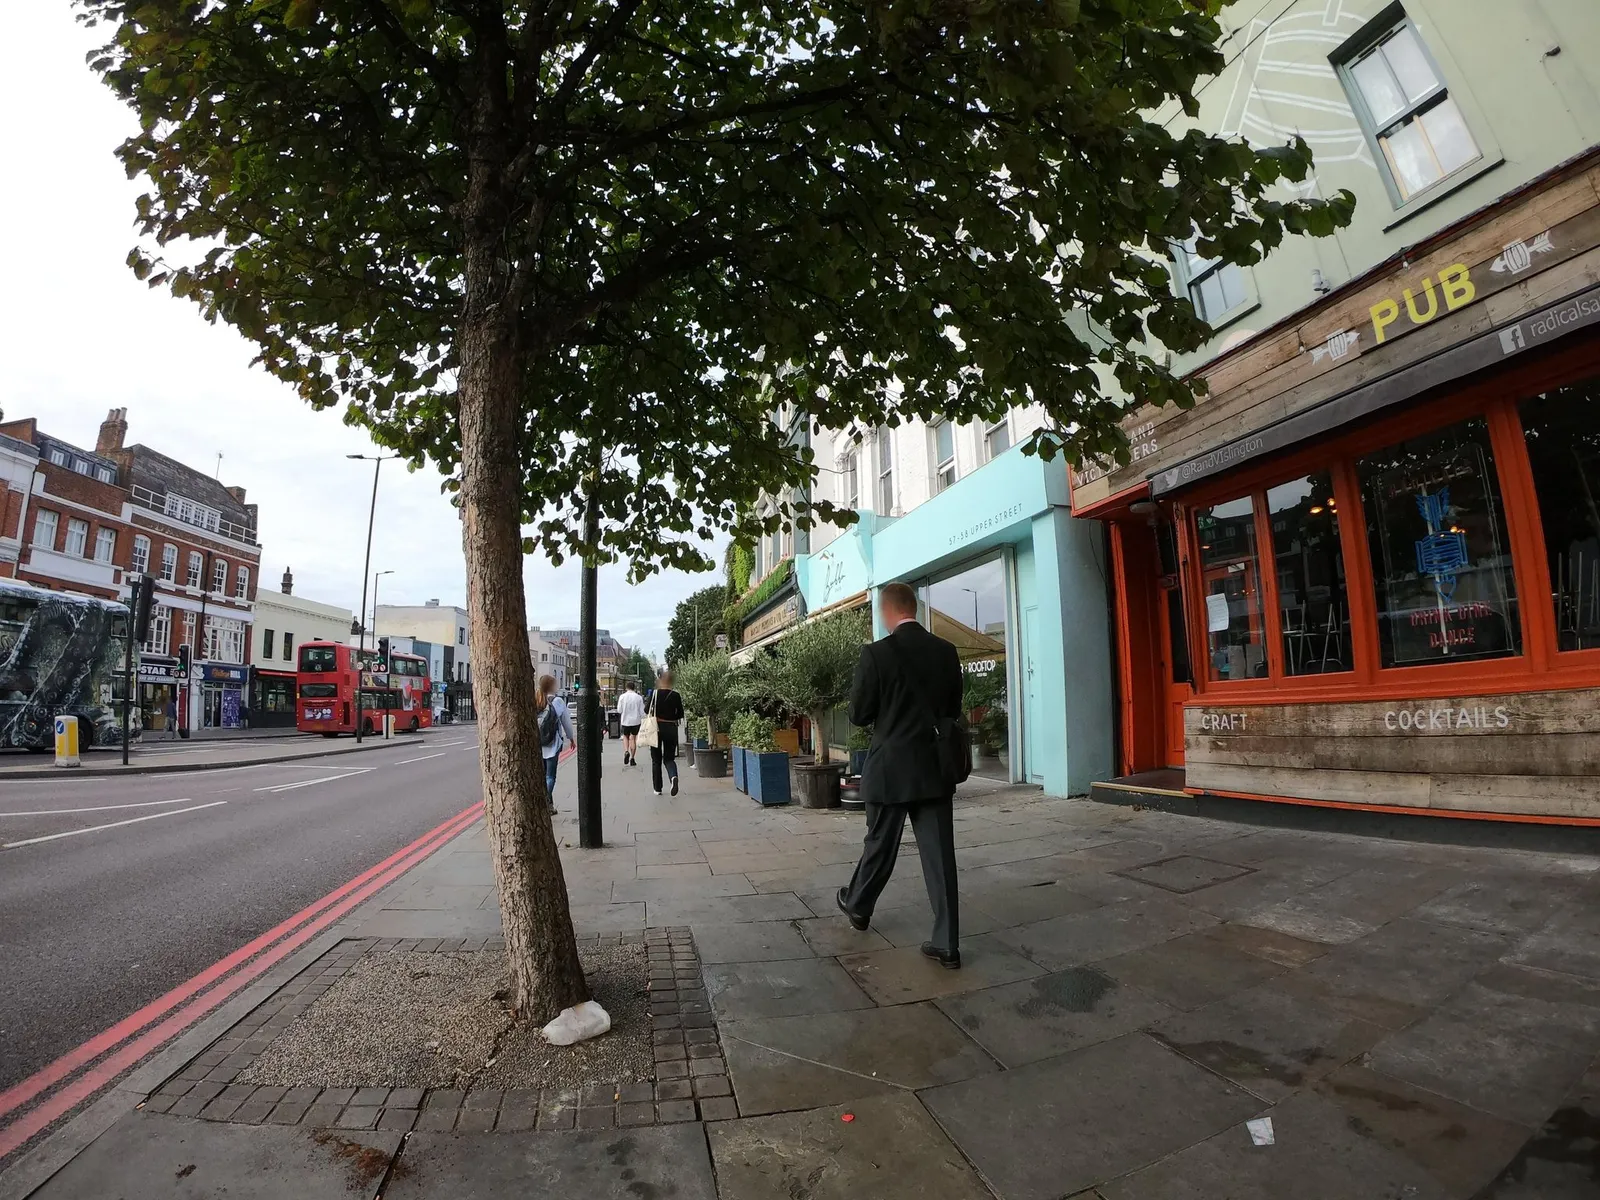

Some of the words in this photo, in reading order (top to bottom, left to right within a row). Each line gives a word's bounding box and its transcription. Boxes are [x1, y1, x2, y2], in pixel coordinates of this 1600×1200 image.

[1369, 263, 1476, 344] PUB
[1530, 296, 1600, 337] radicalsa
[1130, 421, 1156, 445] AND
[1182, 438, 1264, 479] @RandVIslington
[970, 518, 993, 535] UPPER
[994, 503, 1022, 524] STREET
[1429, 627, 1475, 648] DANCE
[140, 665, 166, 676] STAR
[968, 660, 996, 673] ROOFTOP
[1201, 713, 1247, 730] CRAFT
[1384, 706, 1509, 730] COCKTAILS
